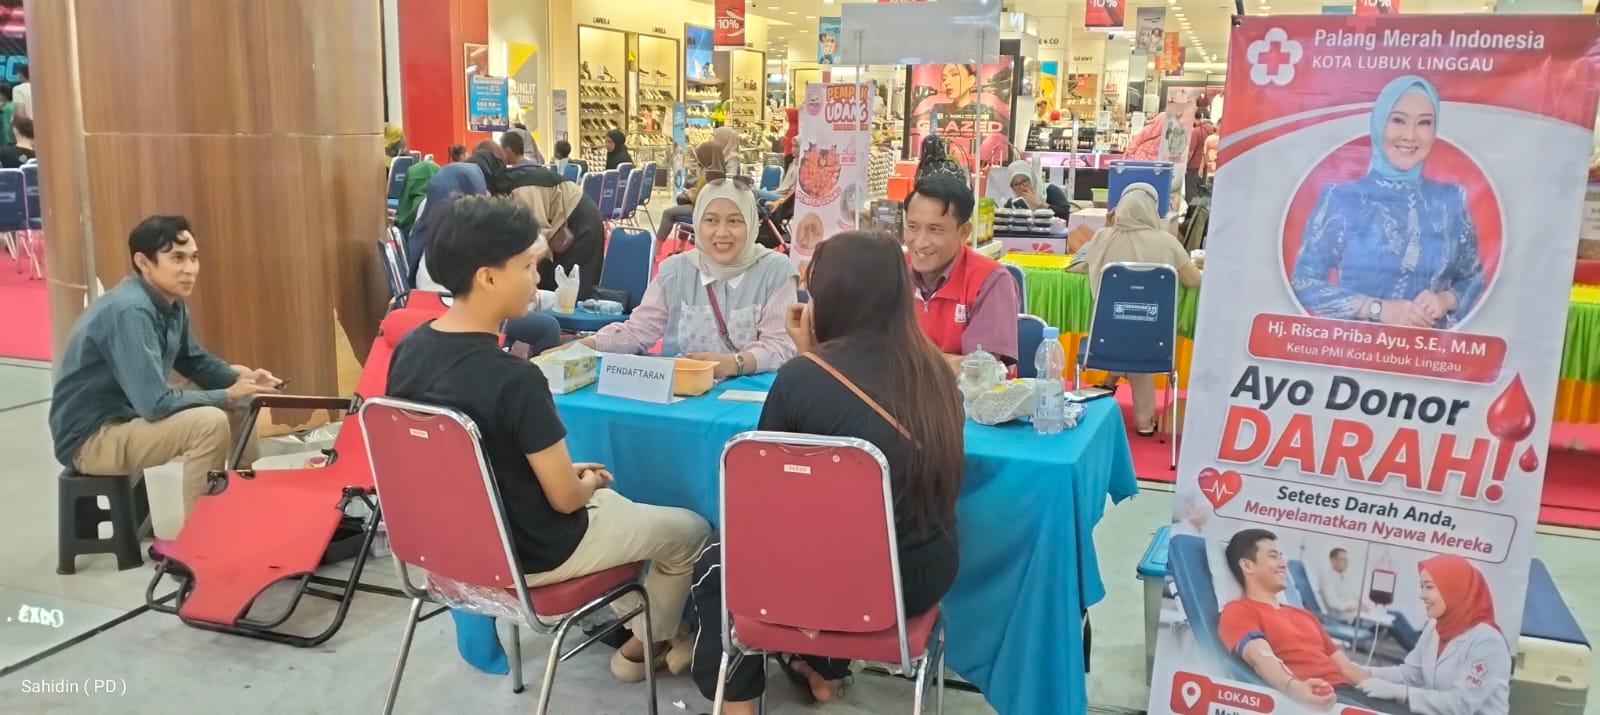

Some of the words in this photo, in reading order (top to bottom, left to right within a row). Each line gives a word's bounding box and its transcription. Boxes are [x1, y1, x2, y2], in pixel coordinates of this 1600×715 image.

[1314, 29, 1376, 50] Palang
[1382, 30, 1442, 48] Merah
[1450, 30, 1545, 49] Indonesia
[1312, 55, 1352, 70] KOTA
[1358, 56, 1412, 70] LUBUK
[1417, 56, 1494, 72] LINGGAU
[826, 85, 868, 101] PEMPK
[1268, 320, 1288, 337] Hj.
[1291, 323, 1329, 340] Risca
[1333, 327, 1373, 345] Priba
[1376, 331, 1410, 351] Ayu,
[1414, 335, 1446, 353] S.E.,
[1450, 339, 1486, 356] M.M
[606, 364, 665, 380] PENDAFTARAN
[1286, 342, 1318, 356] Ketua
[1321, 345, 1344, 359] PMI
[1347, 348, 1373, 361] Kota
[1376, 351, 1411, 366] Lubuk
[1415, 356, 1461, 372] Linggau
[1231, 365, 1314, 410] Ayo
[1325, 375, 1469, 426] Donor
[1217, 405, 1519, 503] DARAH!
[1277, 485, 1339, 509] Setetes
[1344, 495, 1399, 518] Darah
[1403, 505, 1457, 531] Anda,
[1244, 500, 1367, 533] Menyelamatkan
[1371, 520, 1426, 543] Nyawa
[1430, 531, 1493, 554] Mereka
[1217, 690, 1260, 708] LOKASI
